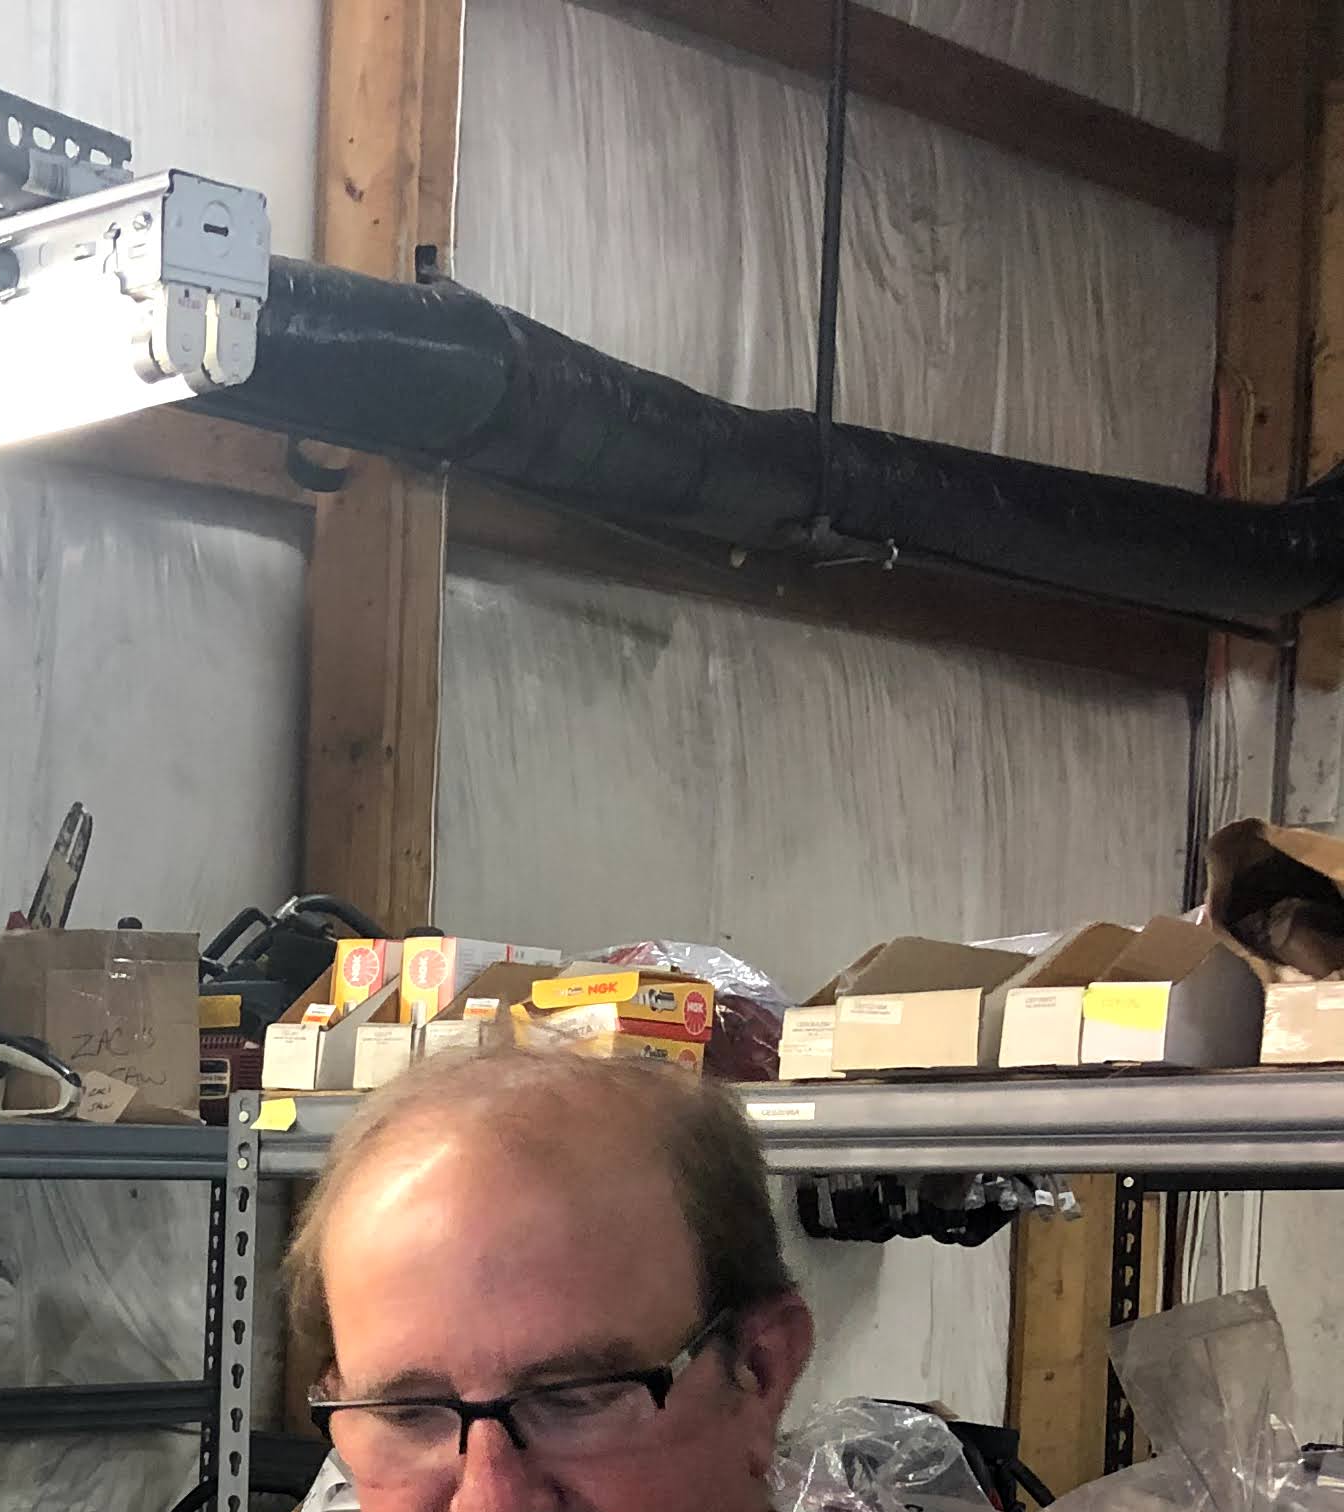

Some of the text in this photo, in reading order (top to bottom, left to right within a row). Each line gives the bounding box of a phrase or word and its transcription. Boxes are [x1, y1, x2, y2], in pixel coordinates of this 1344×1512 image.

[350, 954, 363, 983] NGK
[417, 955, 429, 984] NGK
[587, 981, 618, 996] NGK
[686, 1001, 704, 1014] NGK
